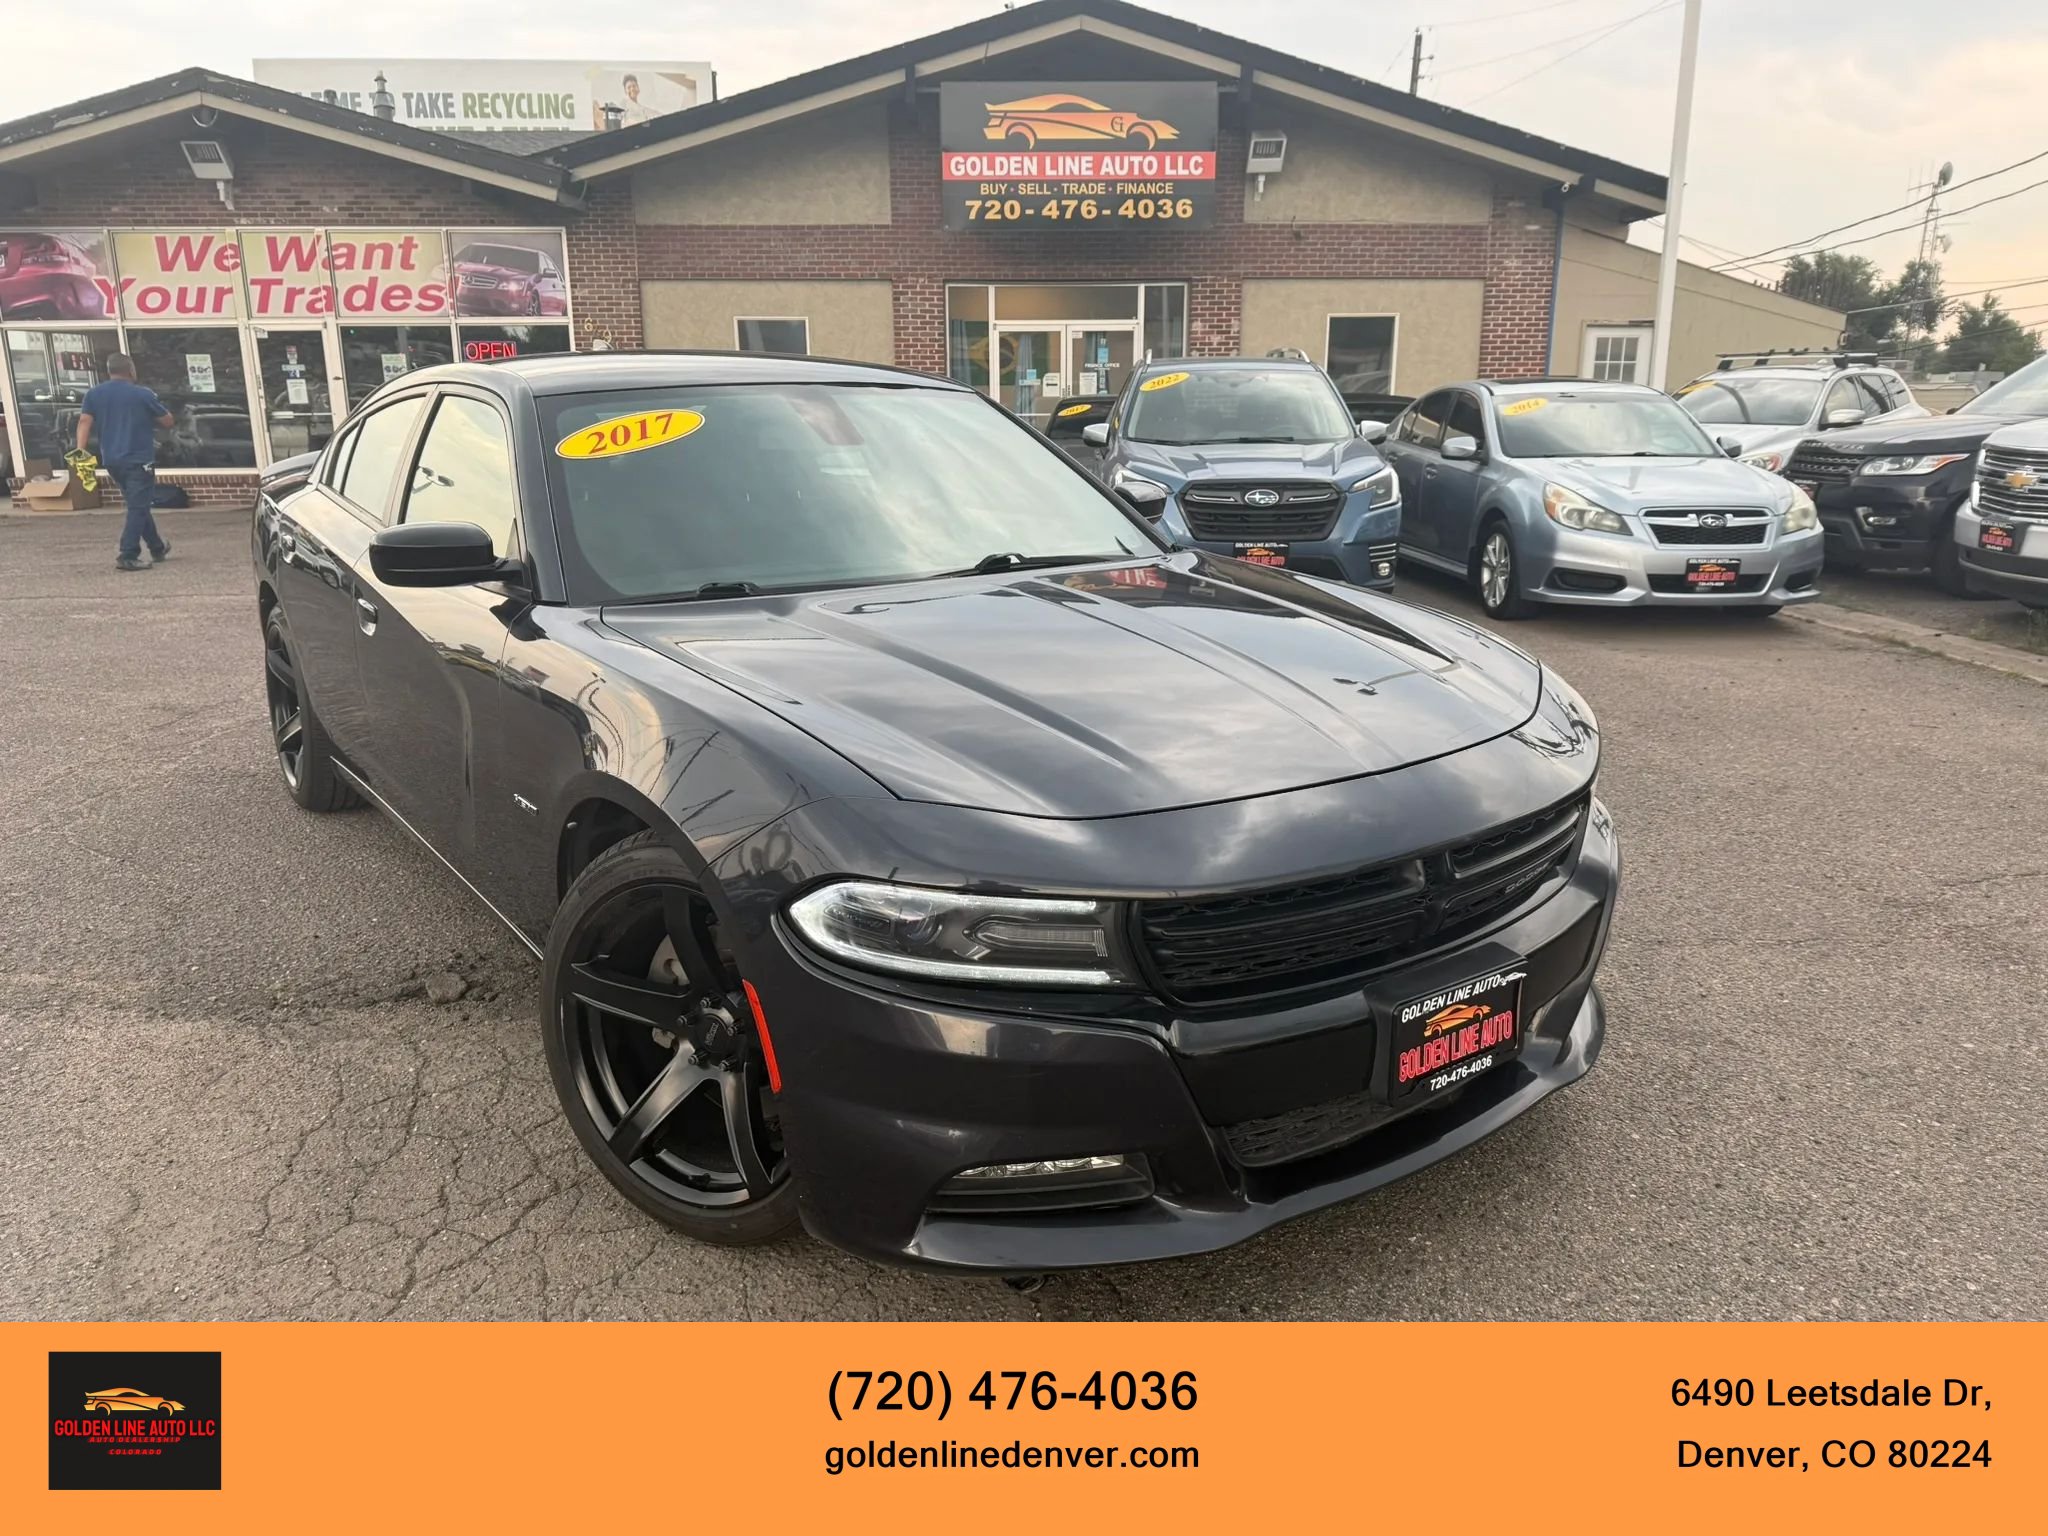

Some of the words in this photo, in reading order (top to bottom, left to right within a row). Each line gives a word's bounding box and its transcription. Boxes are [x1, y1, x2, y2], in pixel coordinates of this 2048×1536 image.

[402, 92, 456, 119] TAKE
[462, 92, 576, 119] RECYCLING
[950, 156, 1037, 177] GOLDEN
[1045, 156, 1093, 176] LINE
[1100, 156, 1158, 176] AUTO
[1165, 155, 1204, 176] LLC
[980, 183, 1008, 195] BUY
[1018, 183, 1051, 195] SELL
[1062, 183, 1106, 195] TRADE
[1116, 182, 1174, 195] FINANCE
[154, 235, 242, 273] We
[265, 234, 419, 273] Want
[93, 277, 234, 314] Your
[465, 342, 516, 361] OPEN
[1150, 374, 1180, 389] 2022
[586, 412, 674, 455] 2017
[1401, 993, 1446, 1023] GOLDEN
[1446, 985, 1472, 1005] LINE
[1472, 974, 1500, 996] AUTO
[1398, 1034, 1450, 1083] GOLDEN
[1450, 1023, 1480, 1061] LINE
[1480, 1010, 1513, 1049] AUTO
[1430, 1055, 1493, 1091] 720-476-4036
